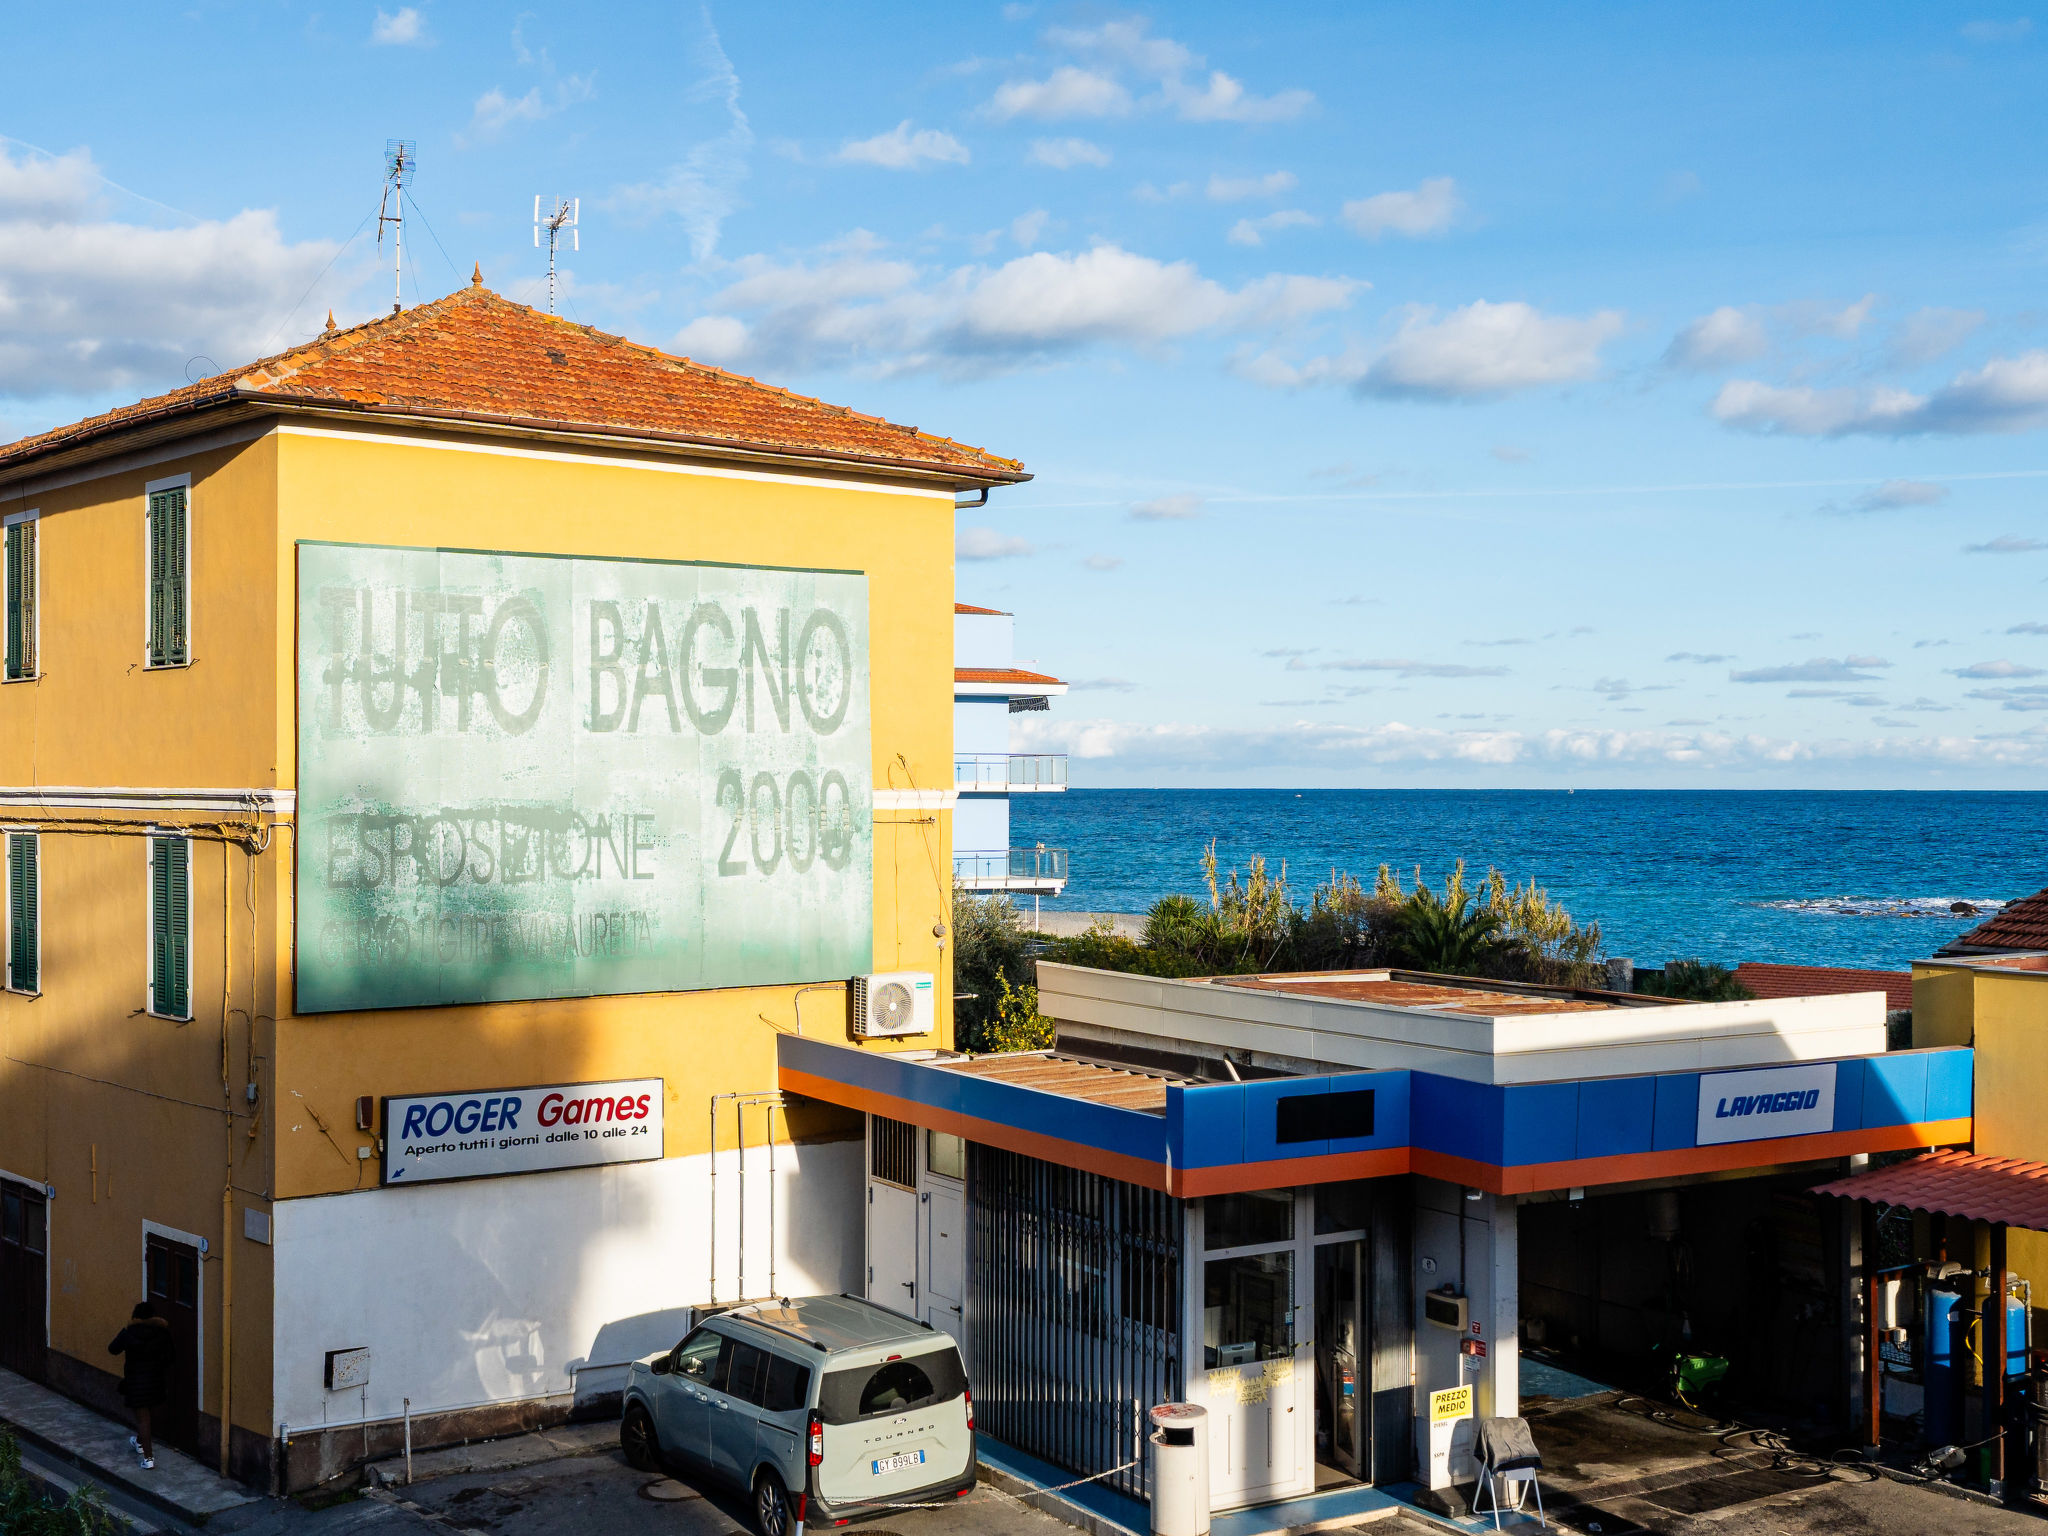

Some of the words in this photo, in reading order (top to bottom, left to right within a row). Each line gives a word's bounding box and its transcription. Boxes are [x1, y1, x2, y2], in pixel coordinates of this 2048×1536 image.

[320, 588, 549, 735] TUTTO
[590, 600, 852, 735] BAGNO
[716, 769, 853, 878] 2000
[326, 812, 656, 889] ESPOSIZIONE
[562, 911, 654, 957] AURELIA
[401, 1096, 522, 1140] ROGER
[537, 1093, 651, 1127] Games
[1716, 1089, 1820, 1118] LAVAGGIO
[404, 1142, 456, 1157] Aperto
[459, 1138, 488, 1151] tutti
[490, 1138, 495, 1148] i
[498, 1133, 539, 1149] giorni
[545, 1130, 579, 1143] dalle
[583, 1129, 599, 1140] 10
[602, 1126, 627, 1138] alle
[630, 1125, 648, 1136] 24
[1436, 1390, 1467, 1403] PREZZO
[1438, 1400, 1466, 1414] MEDIO
[864, 1425, 934, 1443] TOURNEO
[879, 1460, 890, 1471] GY
[892, 1453, 919, 1468] 899LB
